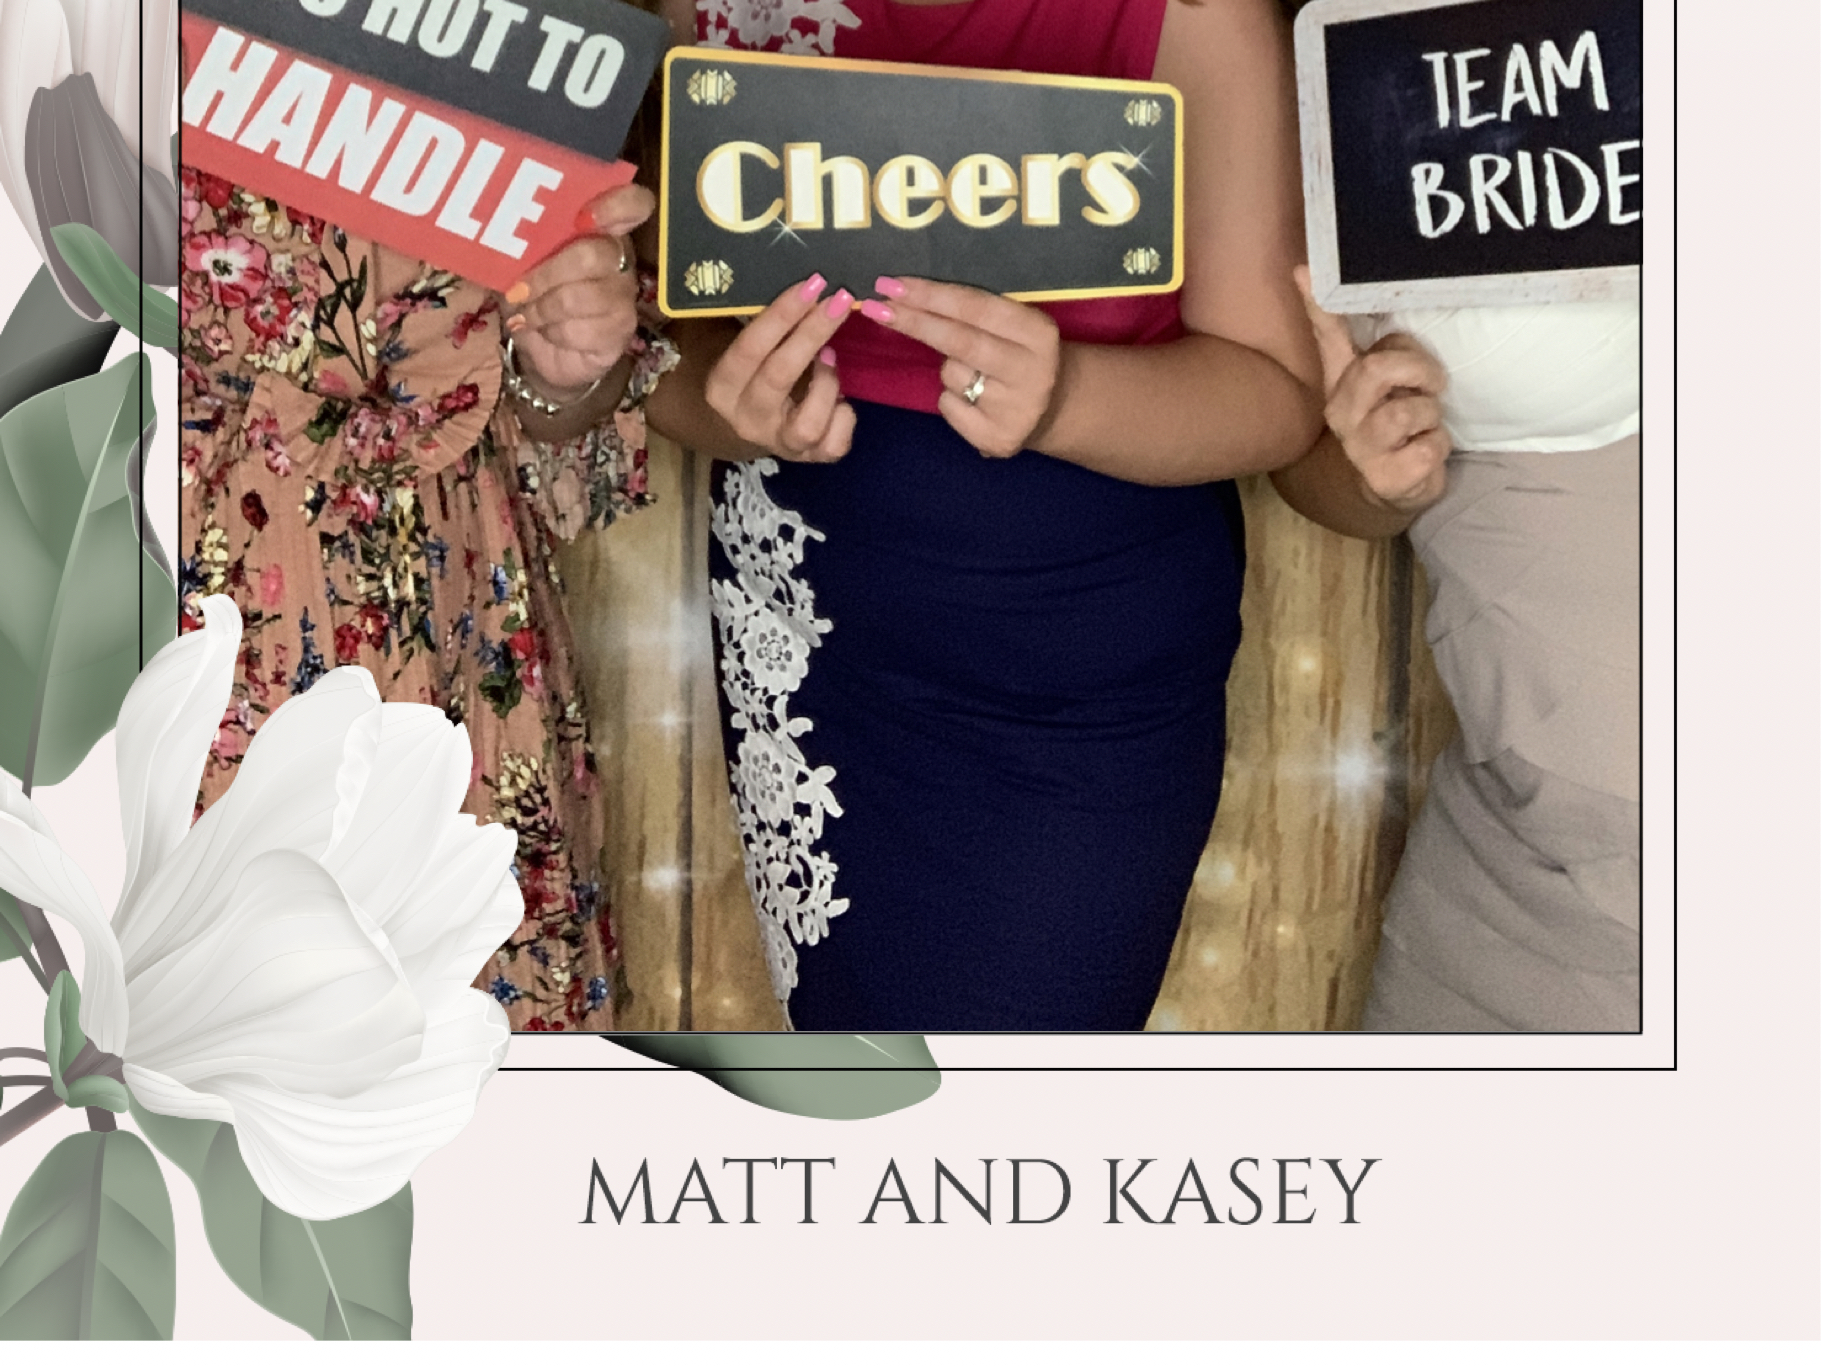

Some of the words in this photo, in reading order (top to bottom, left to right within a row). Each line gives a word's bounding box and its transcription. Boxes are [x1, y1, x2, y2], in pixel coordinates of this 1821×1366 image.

[526, 14, 626, 109] TO
[1421, 30, 1610, 129] TEAM
[181, 25, 565, 261] HANDLE
[695, 140, 1142, 234] Cheers
[1410, 139, 1644, 239] BRIDE
